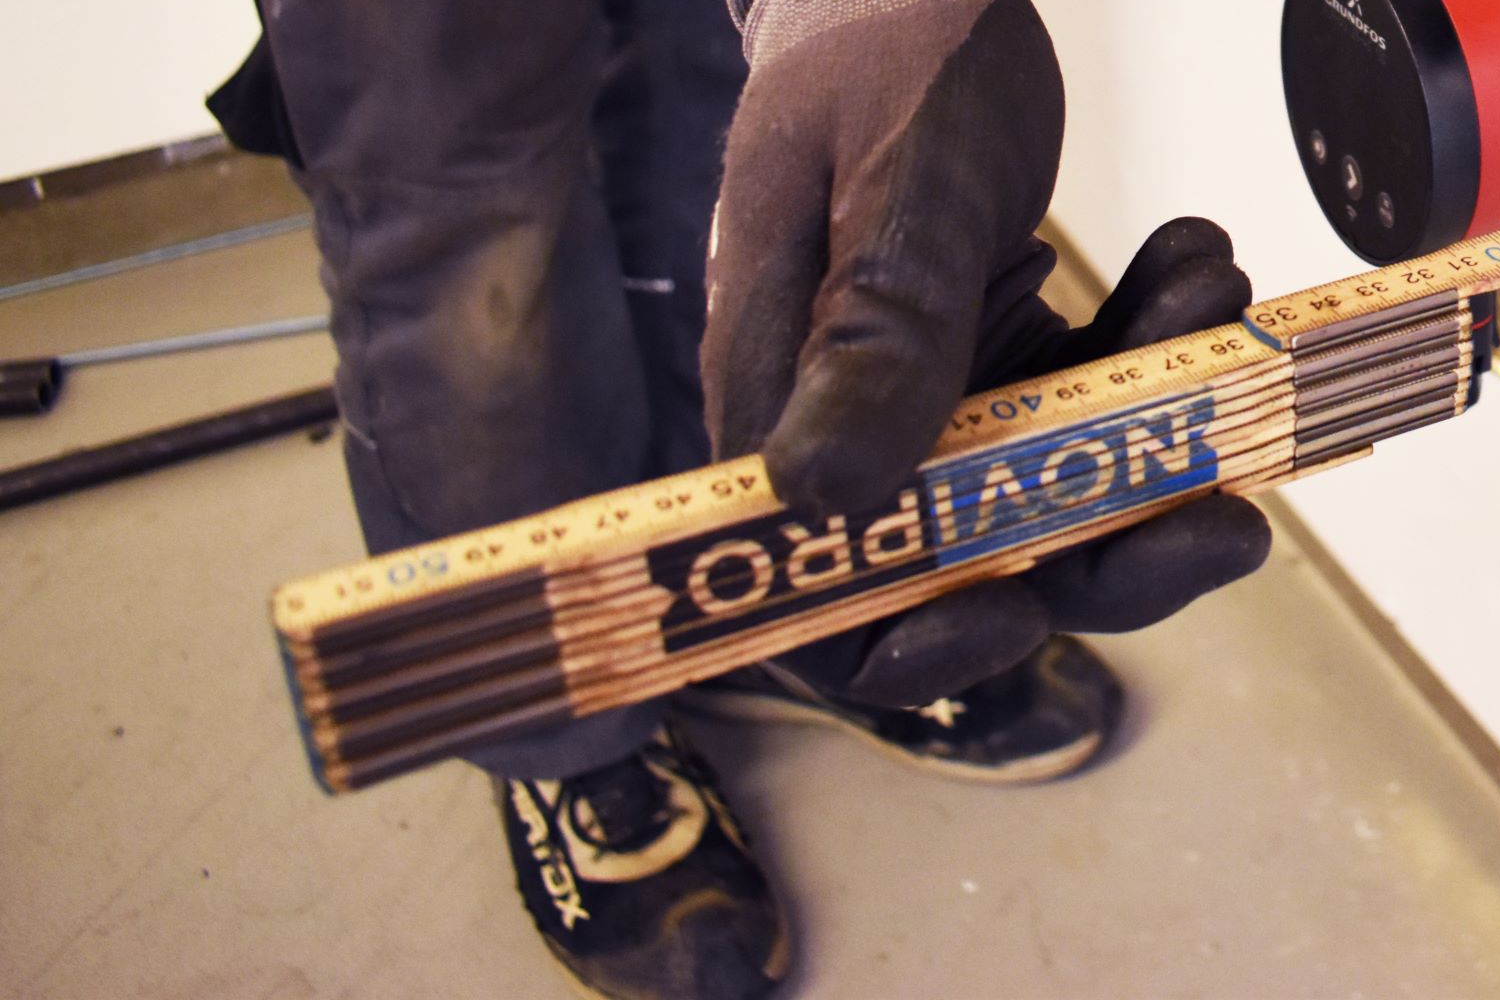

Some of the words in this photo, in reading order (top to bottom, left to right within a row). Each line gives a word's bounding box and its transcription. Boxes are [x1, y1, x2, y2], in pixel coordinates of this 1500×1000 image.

[1448, 255, 1479, 272] 31
[1401, 267, 1435, 285] 32
[1356, 280, 1389, 297] 33
[1310, 294, 1342, 310] 34
[1254, 306, 1297, 327] 35
[1209, 338, 1244, 356] 36
[1165, 352, 1195, 371] 37
[1108, 367, 1143, 385] 38
[1055, 381, 1091, 400] 39
[991, 393, 1042, 421] 40
[949, 411, 983, 432] 41
[711, 474, 757, 497] 45
[655, 491, 692, 511] 46
[597, 509, 630, 530] 47
[687, 405, 1208, 617] NOVIPRO
[387, 552, 449, 587] 50
